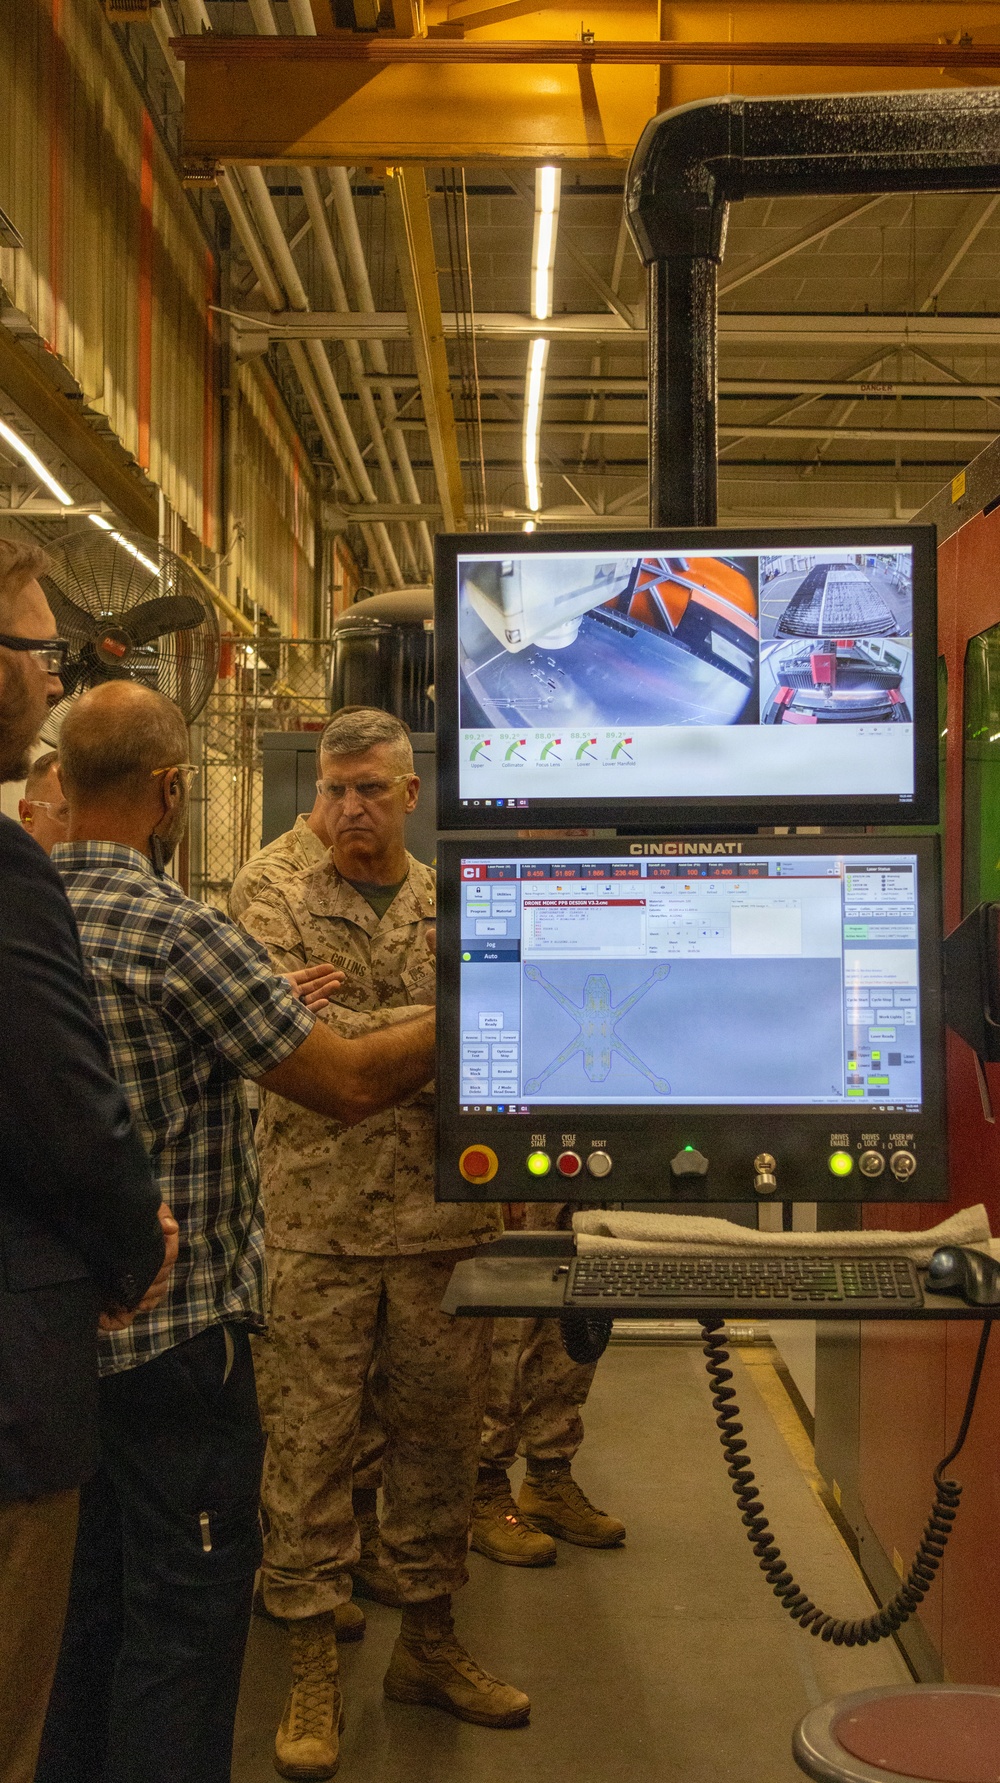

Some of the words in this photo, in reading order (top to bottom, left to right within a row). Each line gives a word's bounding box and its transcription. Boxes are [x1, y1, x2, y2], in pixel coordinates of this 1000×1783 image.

[860, 384, 893, 392] DANGER
[630, 842, 743, 855] CINCINNATI
[463, 867, 480, 878] CI
[330, 952, 366, 977] COLLINS
